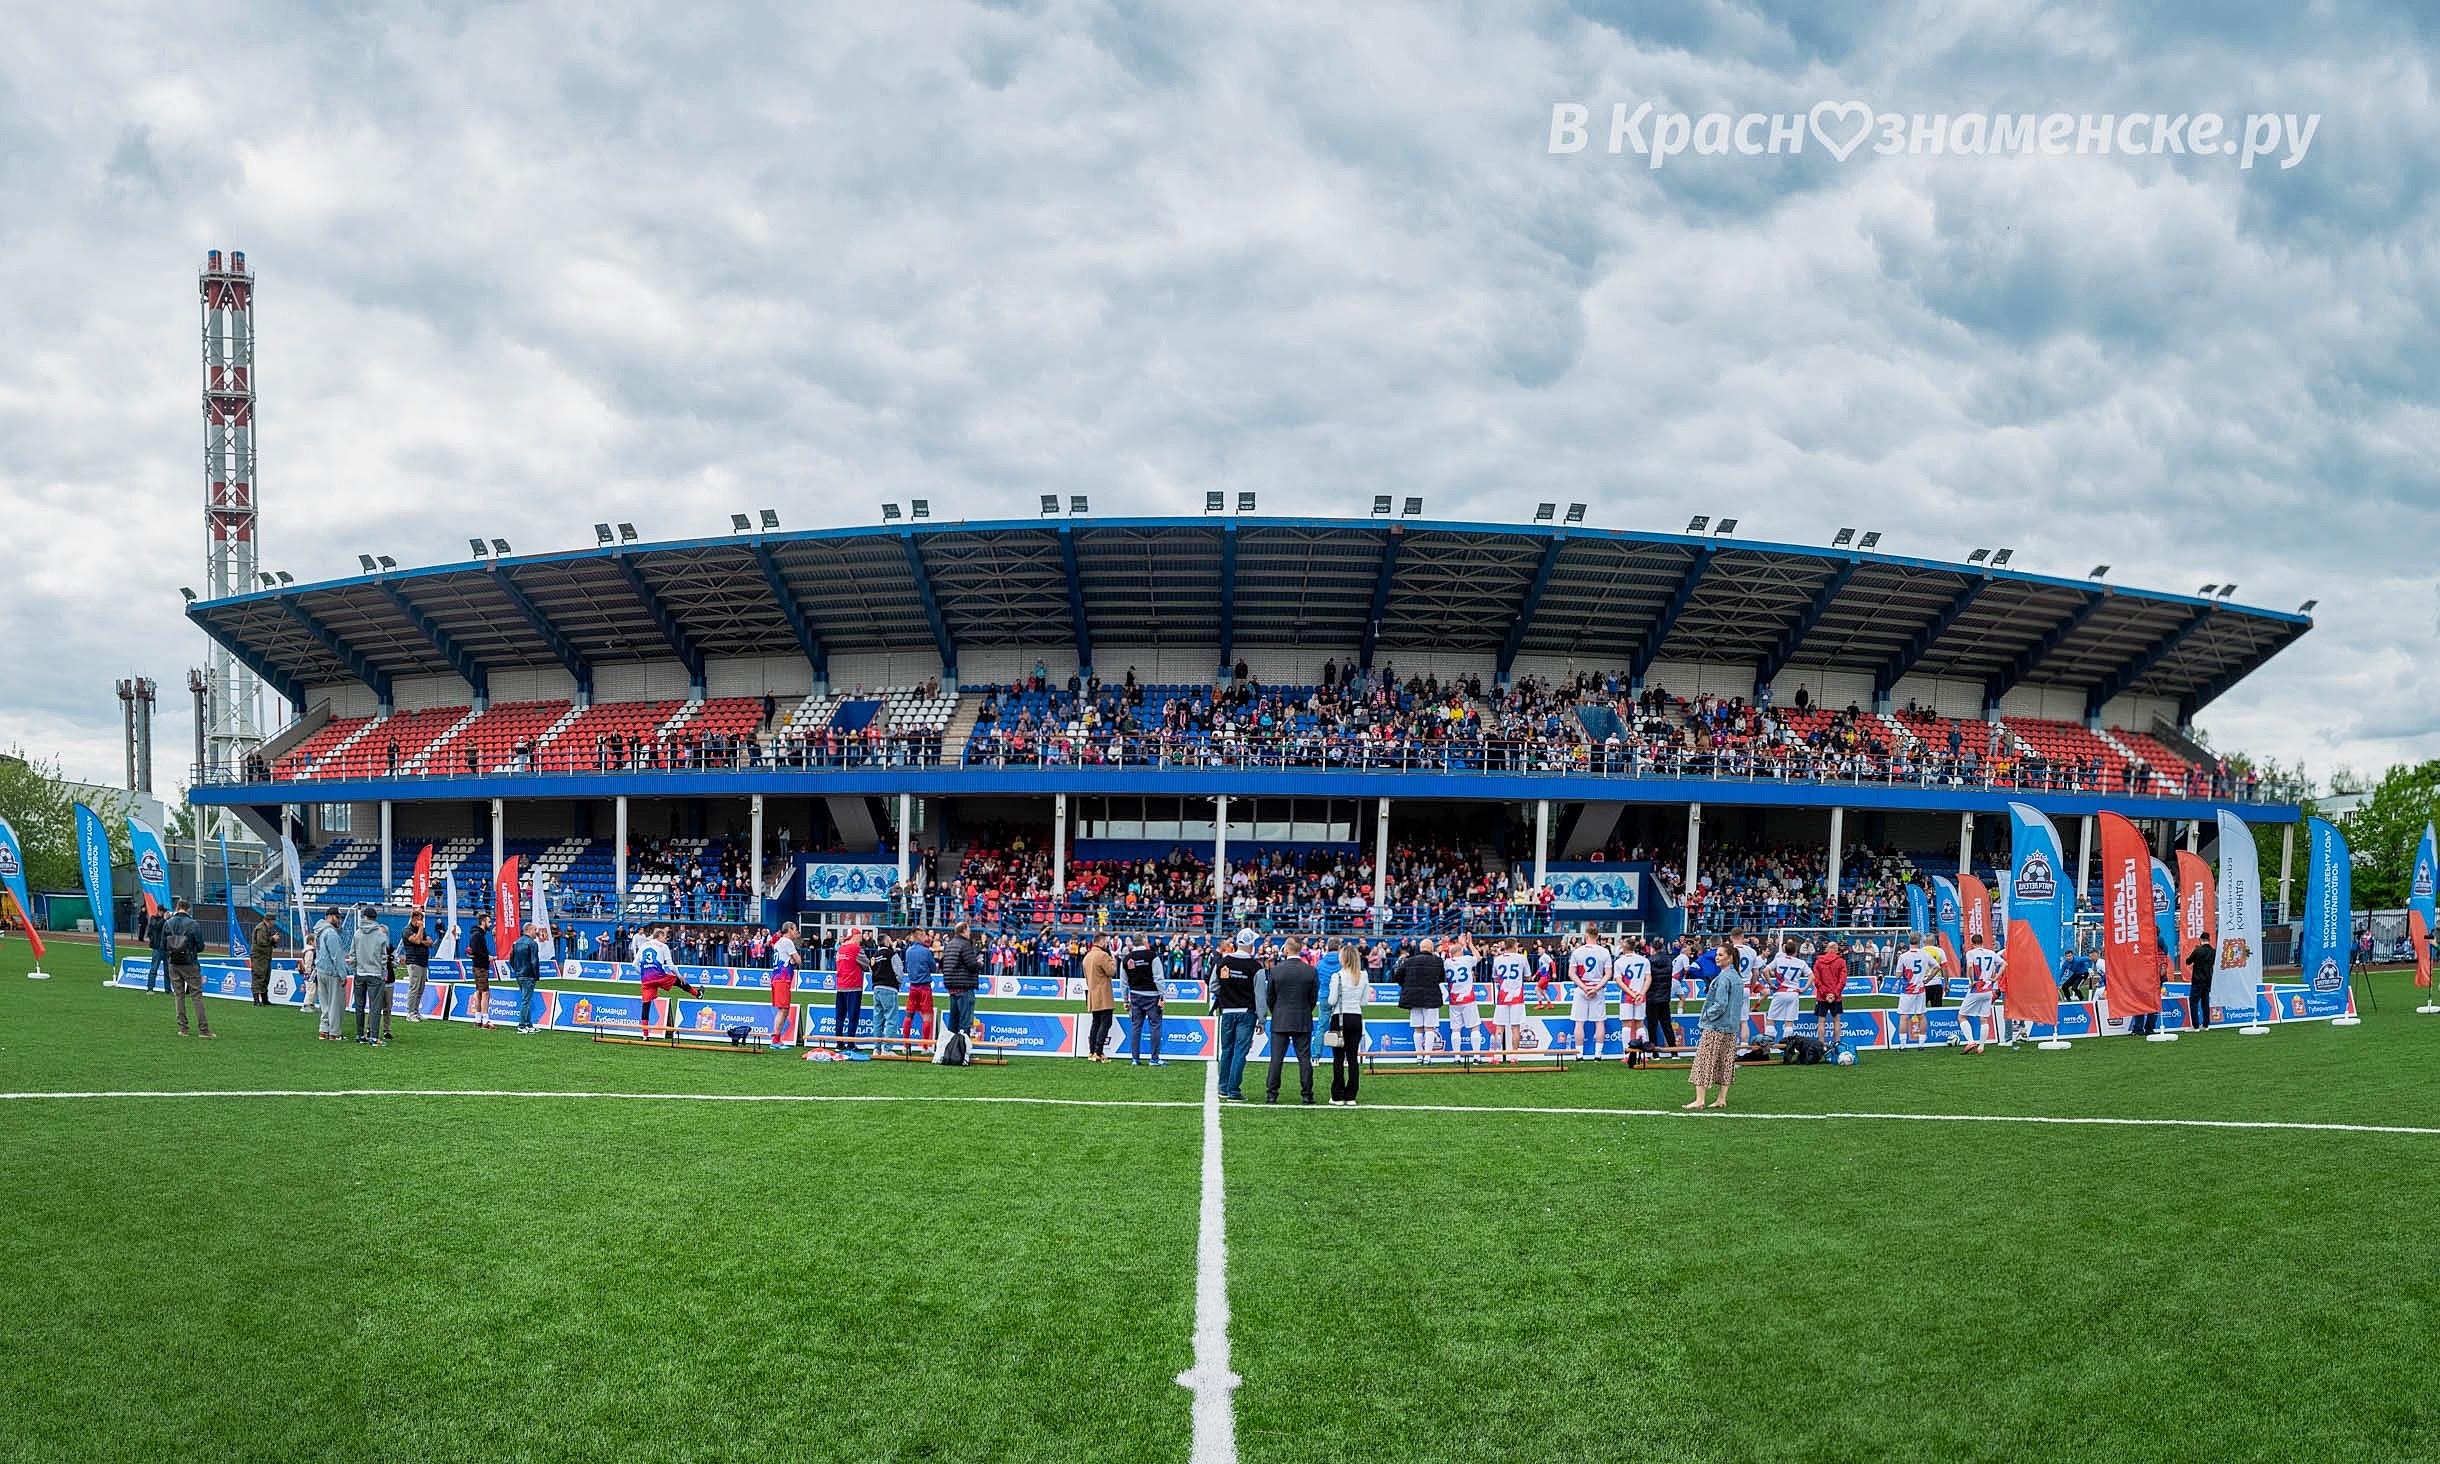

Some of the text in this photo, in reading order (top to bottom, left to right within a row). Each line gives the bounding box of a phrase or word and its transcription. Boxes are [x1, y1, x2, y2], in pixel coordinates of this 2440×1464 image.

[507, 892, 515, 928] СПОРТ
[645, 951, 654, 963] 3
[1584, 956, 1597, 973] 9
[1975, 956, 1992, 971] 17
[1498, 963, 1520, 980] 25
[1624, 963, 1645, 980] 67
[1779, 966, 1800, 981] 77
[1913, 959, 1922, 974] 5
[1446, 966, 1469, 983] 23
[596, 1006, 627, 1016] Команда
[720, 1013, 755, 1024] Команда
[594, 1015, 640, 1025] Губернатора
[990, 1024, 1028, 1035] Команда
[989, 1036, 1044, 1047] Губернатора
